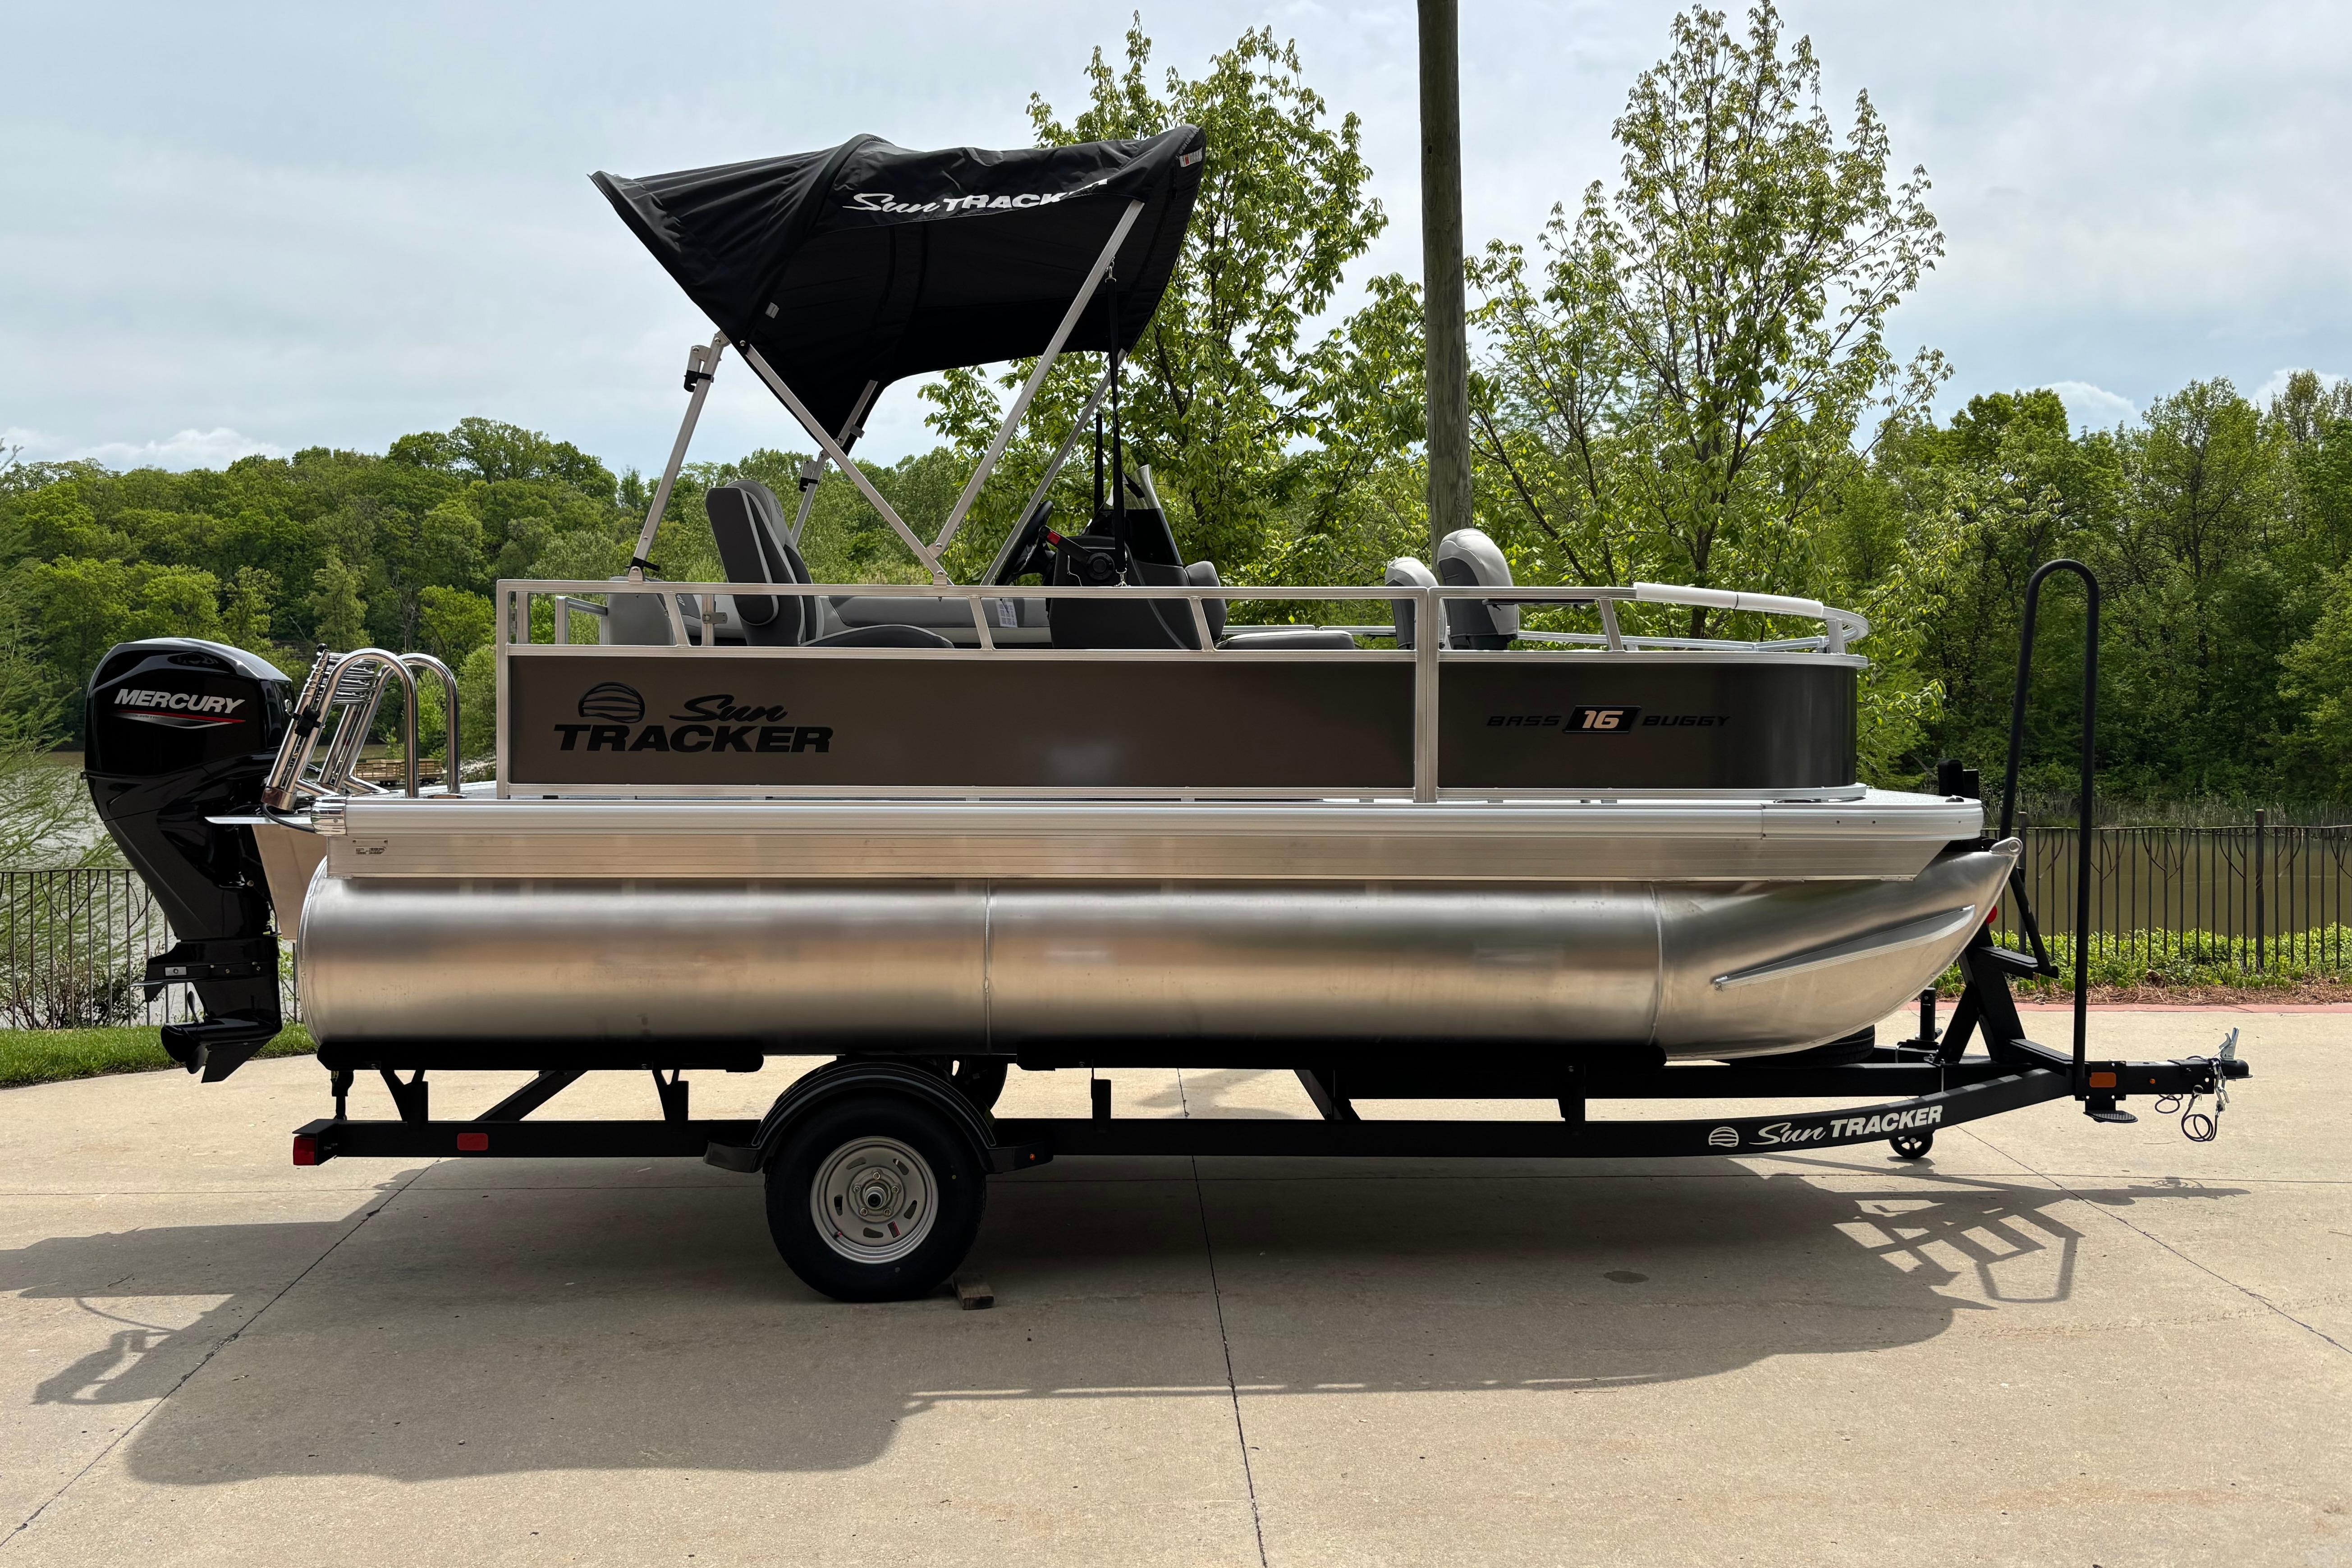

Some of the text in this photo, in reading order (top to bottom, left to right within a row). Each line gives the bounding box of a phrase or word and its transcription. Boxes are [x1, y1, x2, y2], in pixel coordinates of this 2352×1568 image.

[842, 179, 1107, 213] Sun TRACK
[114, 688, 245, 714] MERCURY
[669, 694, 788, 722] Sun
[1487, 710, 1731, 729] BASS 16 BUGGY
[554, 724, 834, 753] TRACKER
[1748, 1105, 1943, 1146] Sun TRACKER
